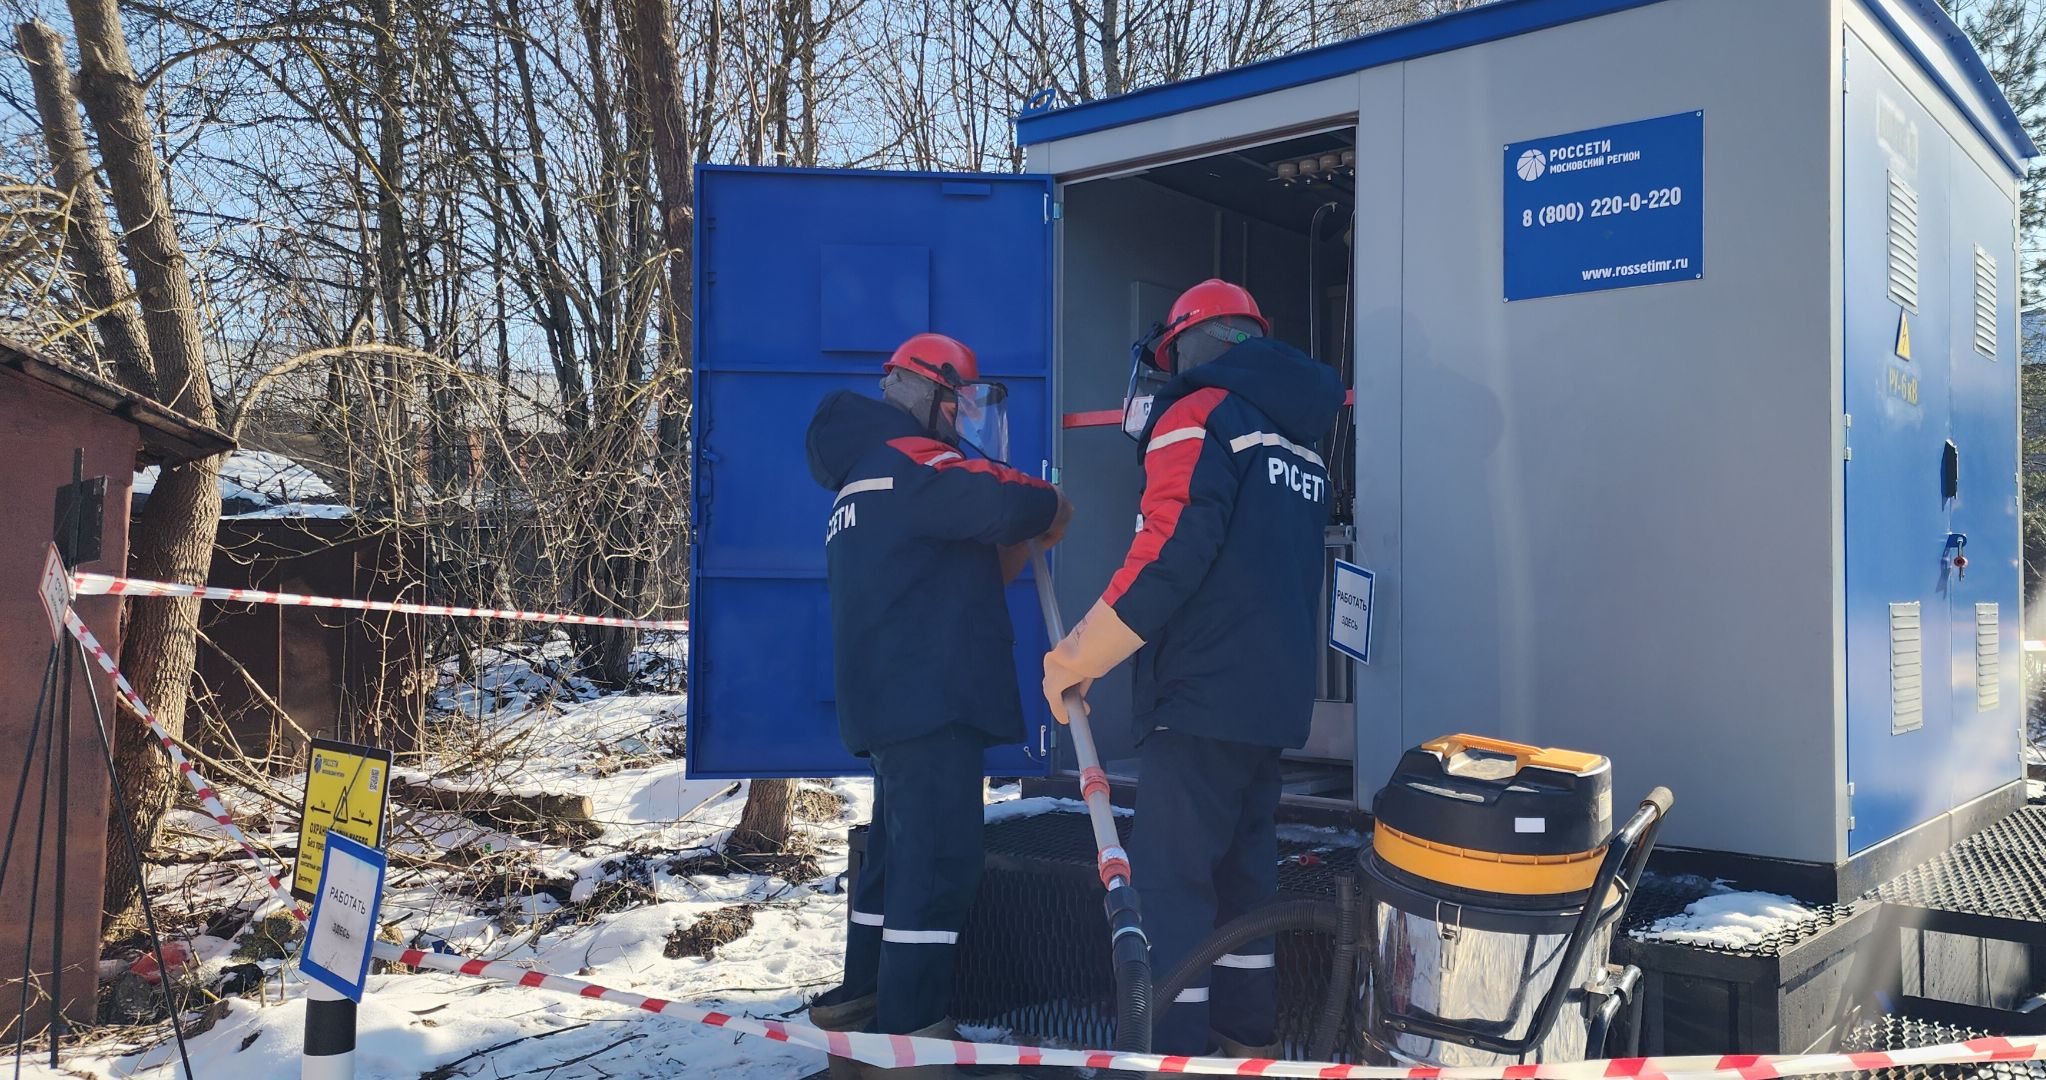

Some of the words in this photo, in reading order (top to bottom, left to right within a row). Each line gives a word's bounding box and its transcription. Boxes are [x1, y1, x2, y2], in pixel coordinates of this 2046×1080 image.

[1550, 139, 1611, 162] РОССЕТИ
[1550, 155, 1605, 174] МОСКОВСКИЙ
[1607, 151, 1641, 165] РЕГИОН
[1522, 209, 1533, 227] 8
[1539, 202, 1584, 227] (800)
[1591, 187, 1682, 217] 220-0-220
[1582, 258, 1689, 281] www.rossetimr.ru
[1337, 590, 1368, 612] РАБОТАТЬ
[1341, 615, 1359, 631] ЗДЕСЬ
[329, 886, 366, 915] РАБОТАТЬ
[331, 922, 351, 939] ЗДЕСЬ
